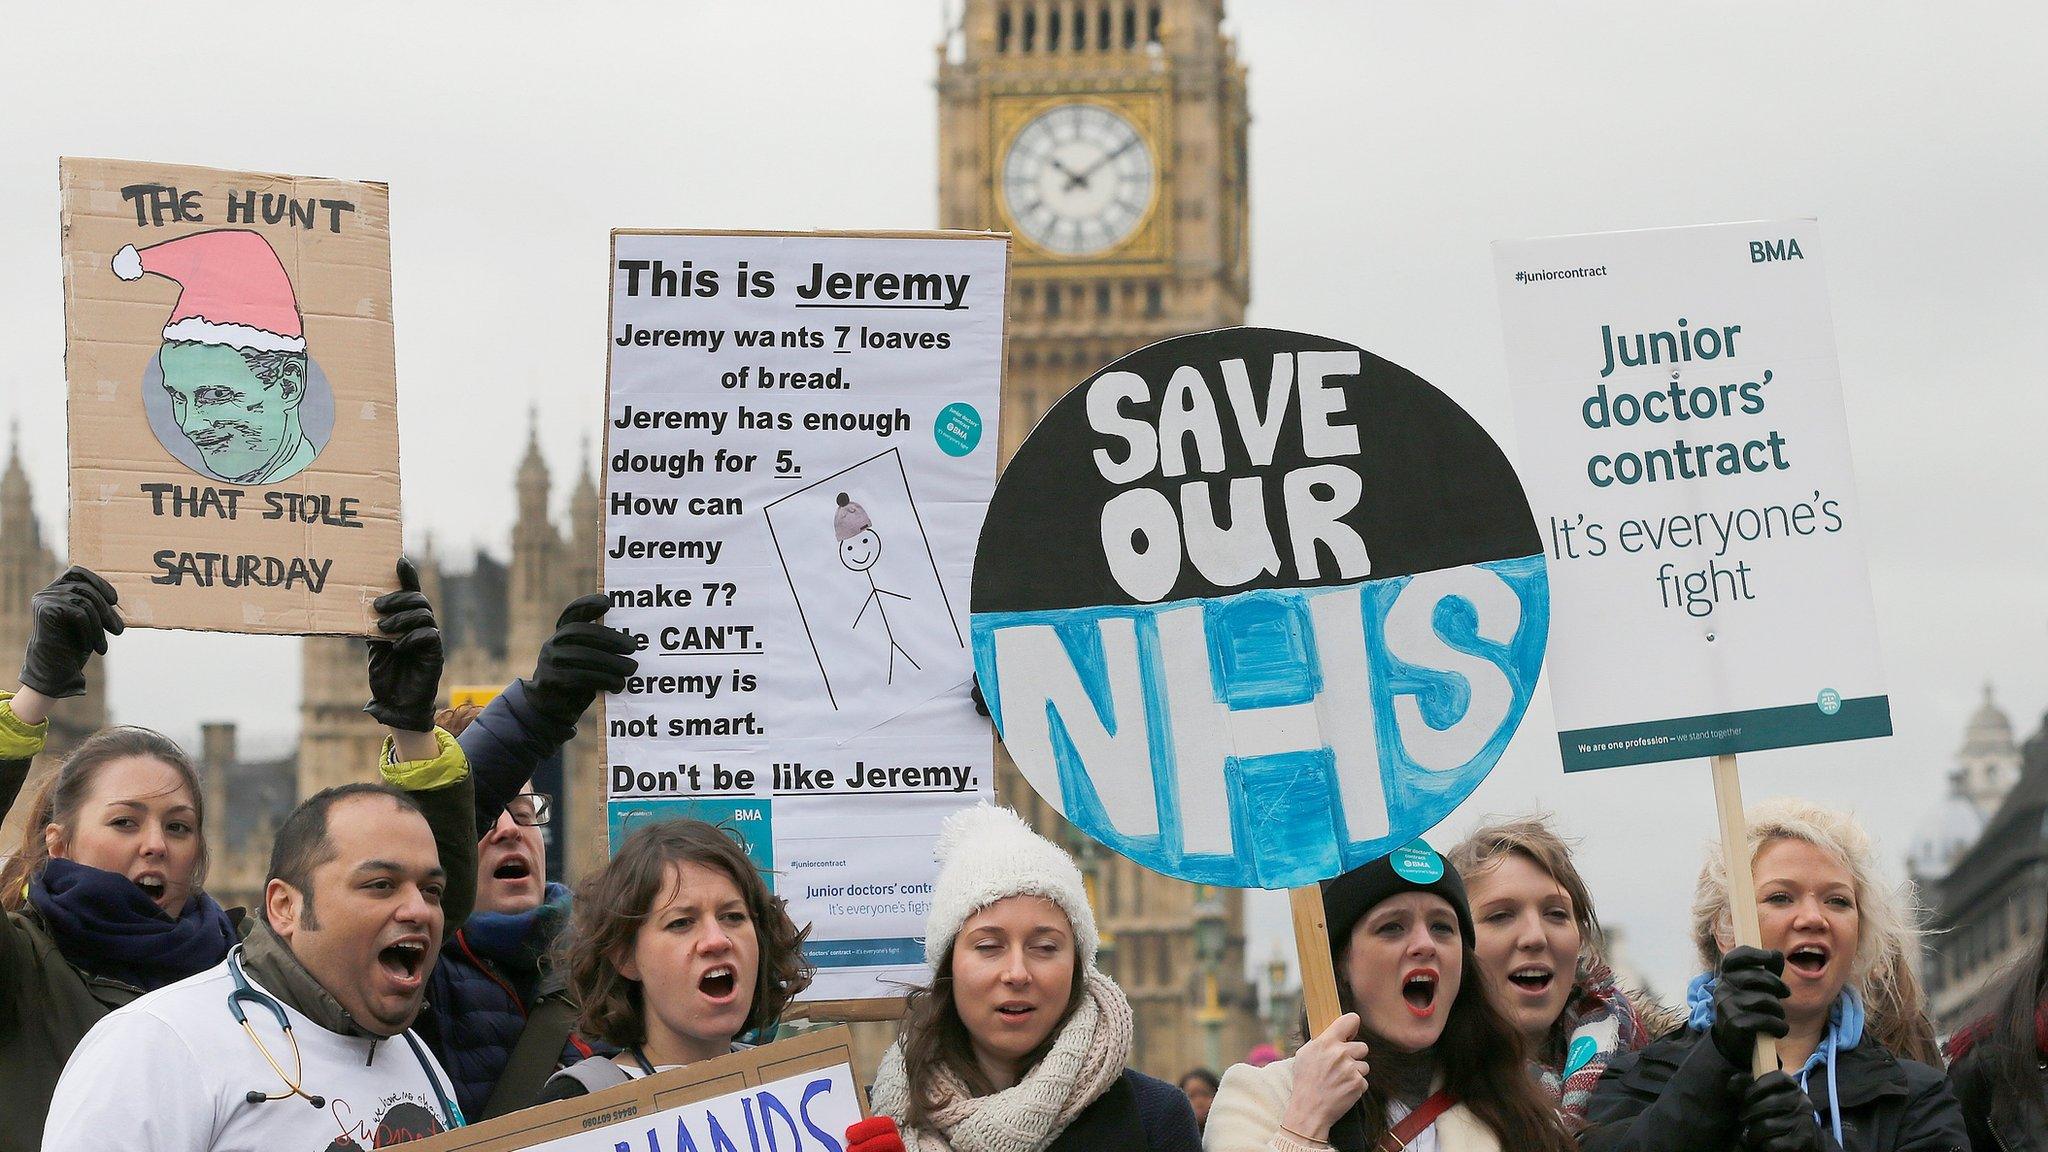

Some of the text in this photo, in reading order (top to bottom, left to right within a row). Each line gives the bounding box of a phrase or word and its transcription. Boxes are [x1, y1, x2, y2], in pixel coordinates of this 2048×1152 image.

[121, 183, 354, 233] THE HUNT
[1749, 238, 1804, 263] BMA
[619, 261, 970, 310] This is Jeremy
[1515, 265, 1607, 284] #juniorcontract
[616, 324, 951, 352] Jeremy wants 7 loaves
[1600, 318, 1742, 378] Junior
[721, 367, 851, 389] of bread.
[1582, 369, 1773, 429] doctors’
[614, 406, 910, 436] Jeremy has enough
[1085, 350, 1361, 485] SAVE
[611, 449, 802, 478] dough for 5.
[1587, 431, 1790, 488] contract
[141, 483, 363, 528] THAT STOLE
[611, 493, 743, 516] How can
[1100, 464, 1372, 603] OUR
[1551, 490, 1843, 560] It’s everyone’s
[609, 536, 722, 565] Jeremy
[151, 550, 333, 593] SATURDAY
[608, 583, 737, 608] make 7?
[1656, 560, 1756, 617] fight
[659, 626, 763, 650] CAN'T.
[624, 670, 757, 699] eremy is
[610, 712, 764, 737] not smart.
[992, 564, 1523, 856] NHS
[1578, 744, 1591, 753] We
[1607, 742, 1624, 750] one
[1625, 736, 1669, 750] profession
[1676, 734, 1688, 742] we
[1689, 730, 1710, 740] stand
[1710, 728, 1742, 741] together
[612, 762, 978, 793] Don't be like Jeremy.
[735, 809, 762, 821] BMA
[791, 860, 846, 869] #juniorcontract
[806, 885, 844, 899] Junior
[847, 883, 897, 896] doctors’
[828, 900, 932, 917] It's everyone's figh
